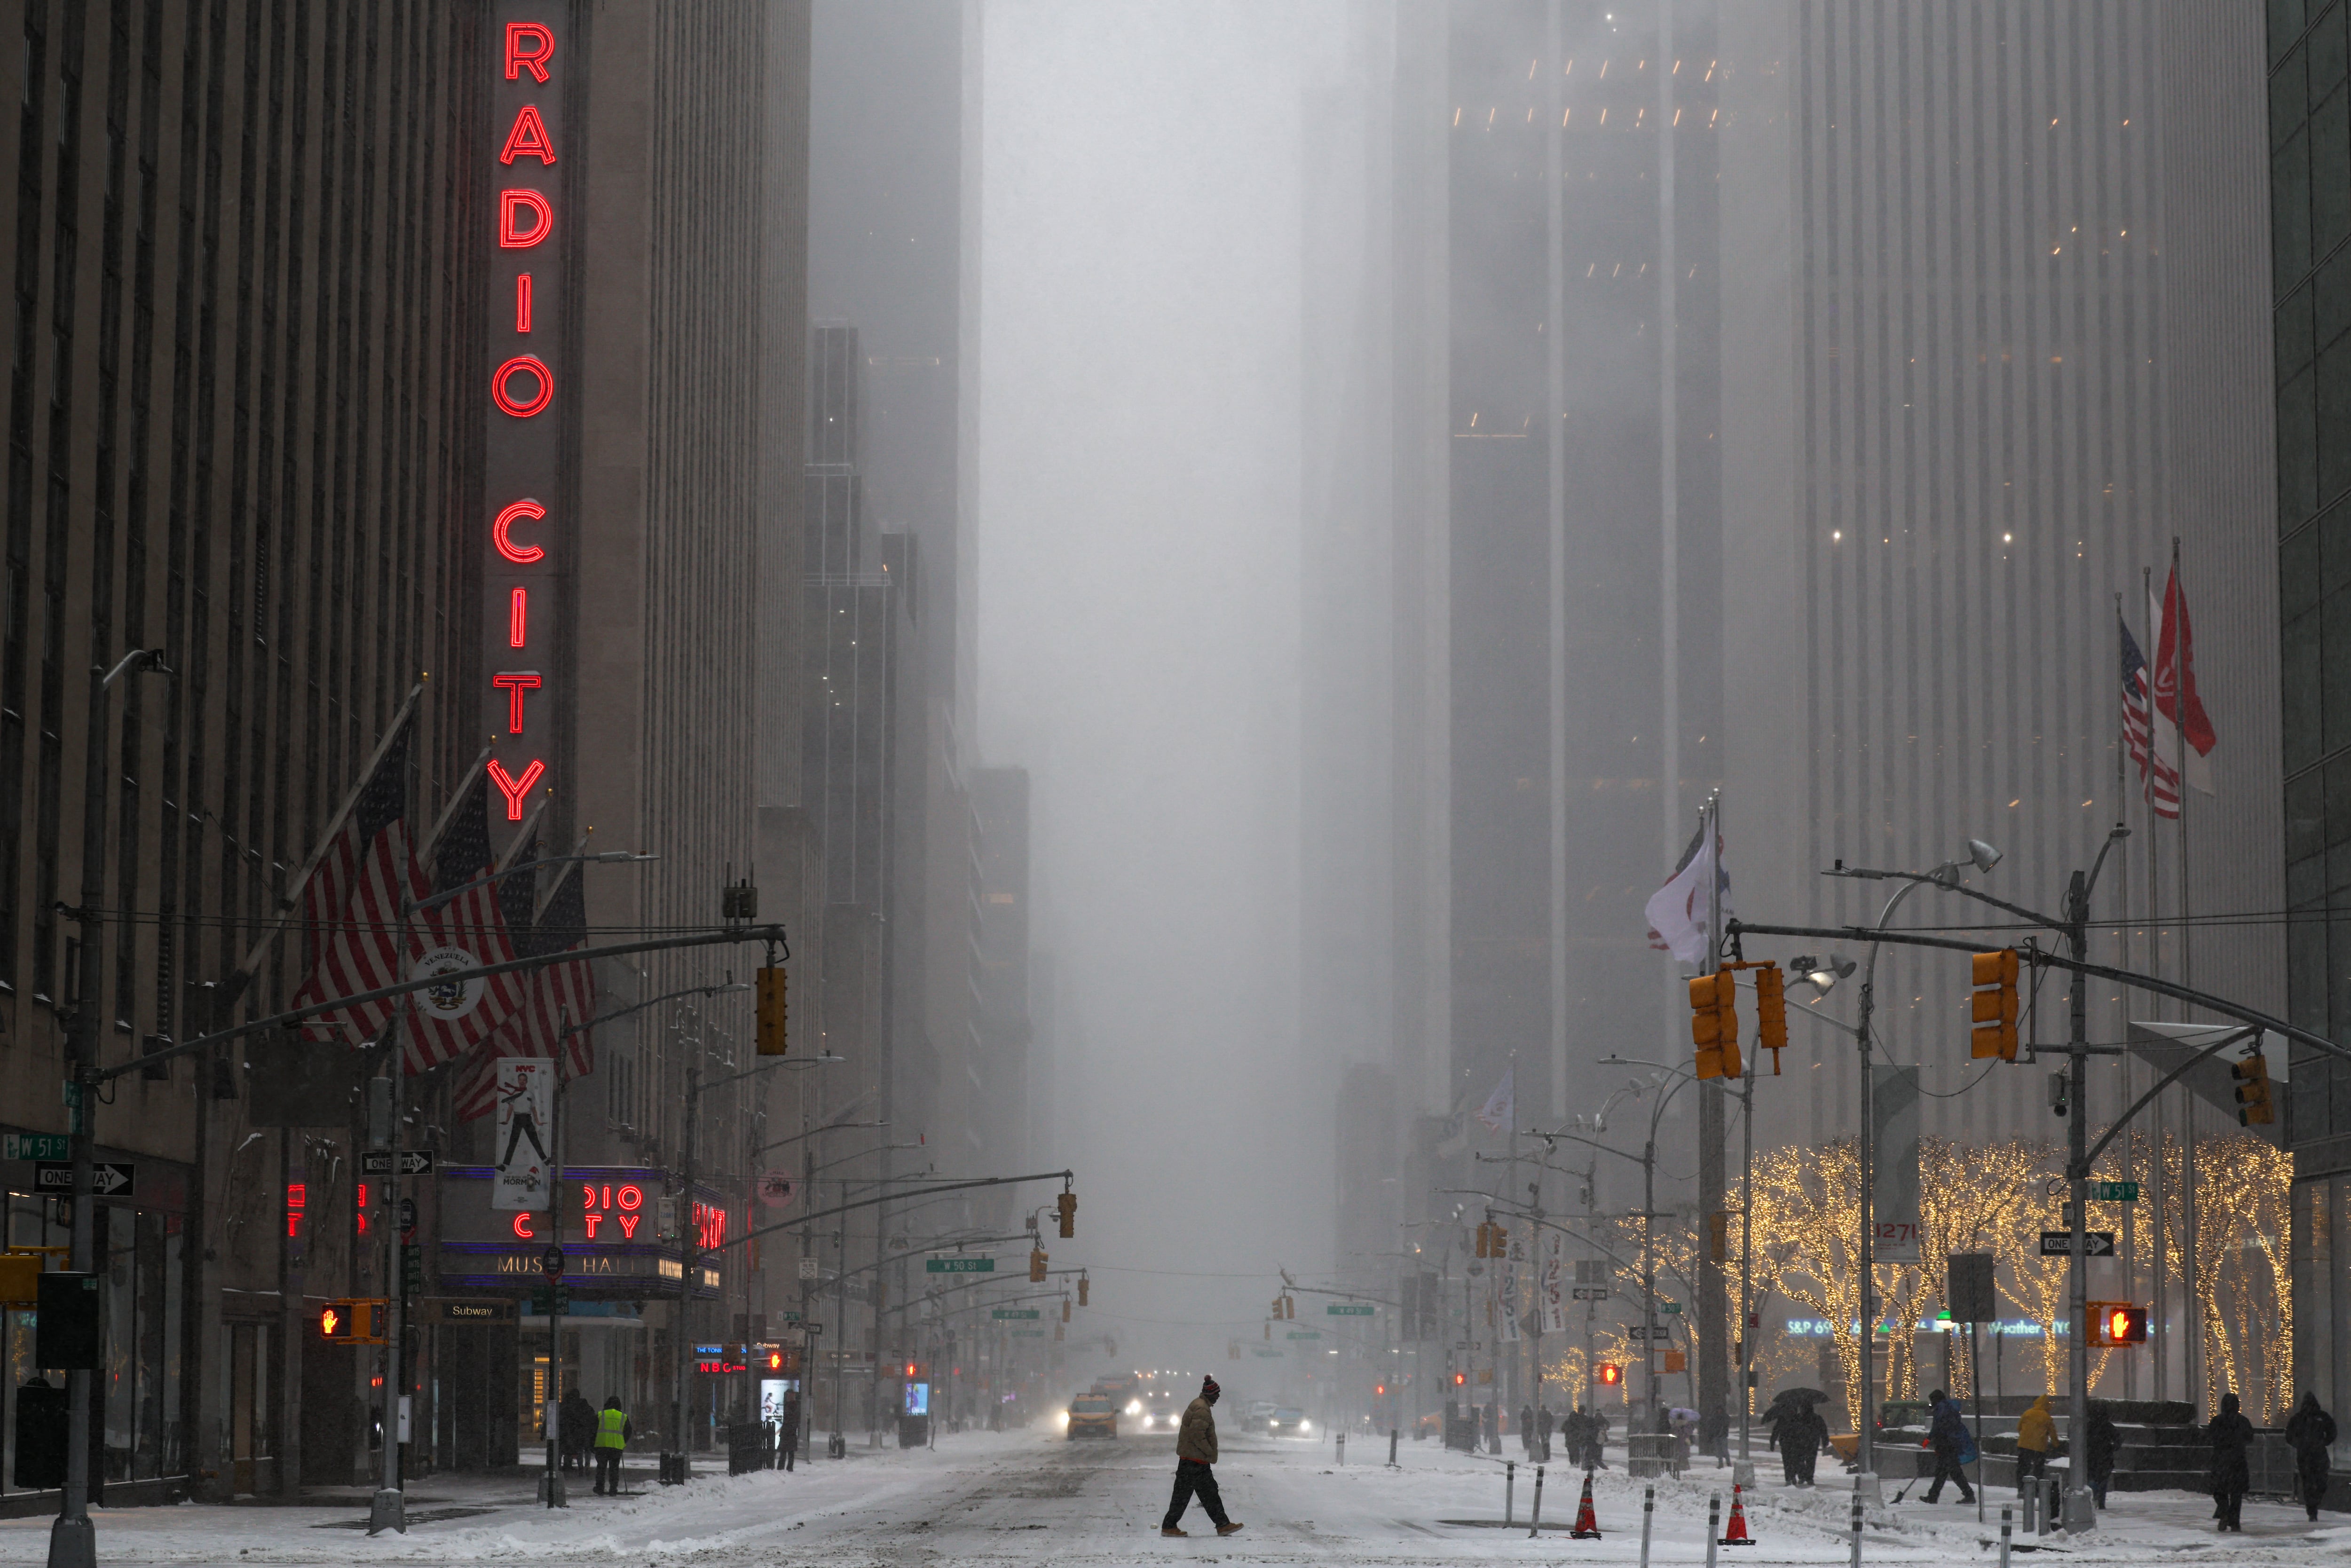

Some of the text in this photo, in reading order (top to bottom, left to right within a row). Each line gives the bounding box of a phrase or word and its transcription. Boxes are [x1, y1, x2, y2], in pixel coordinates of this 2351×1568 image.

[487, 23, 557, 820] RADIO CITY
[425, 952, 469, 967] VENEZUELA
[22, 1138, 66, 1157] W 51 St
[372, 1158, 422, 1168] ONE WAY
[45, 1170, 115, 1186] ONE AY
[2103, 1186, 2111, 1198] W
[2115, 1186, 2124, 1198] 51
[513, 1212, 640, 1239] CTY
[1876, 1223, 1916, 1241] 1271
[2048, 1239, 2099, 1248] ONE AY
[497, 1256, 640, 1274] MUS HALL
[944, 1262, 977, 1270] W 50 St
[452, 1305, 493, 1317] Subway
[1788, 1320, 1811, 1334] S&P
[1988, 1320, 2042, 1334] Weather
[700, 1362, 732, 1373] NBC
